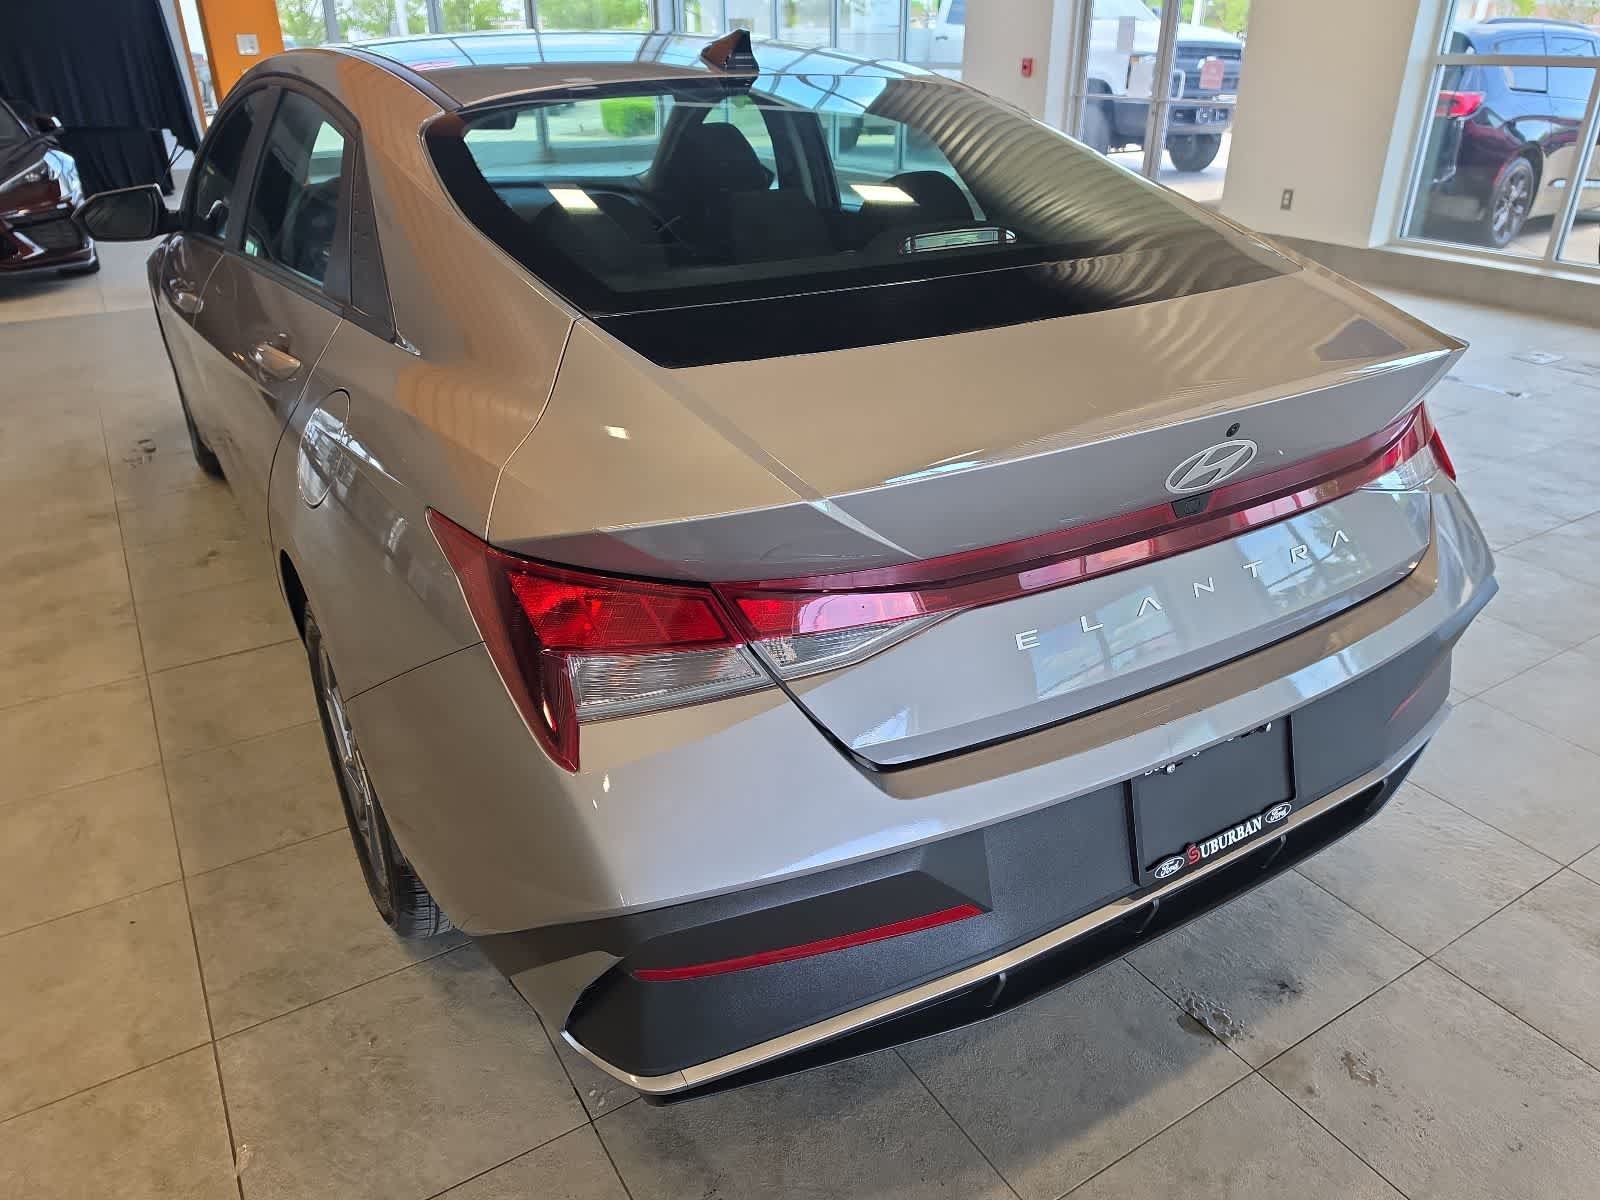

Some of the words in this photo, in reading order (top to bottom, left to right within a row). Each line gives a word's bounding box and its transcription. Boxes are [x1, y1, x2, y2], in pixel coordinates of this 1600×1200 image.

[1014, 529, 1350, 652] ELANTRA
[1159, 858, 1181, 876] Ford
[1186, 816, 1263, 865] SUBURBAN
[1269, 804, 1288, 822] Ford
